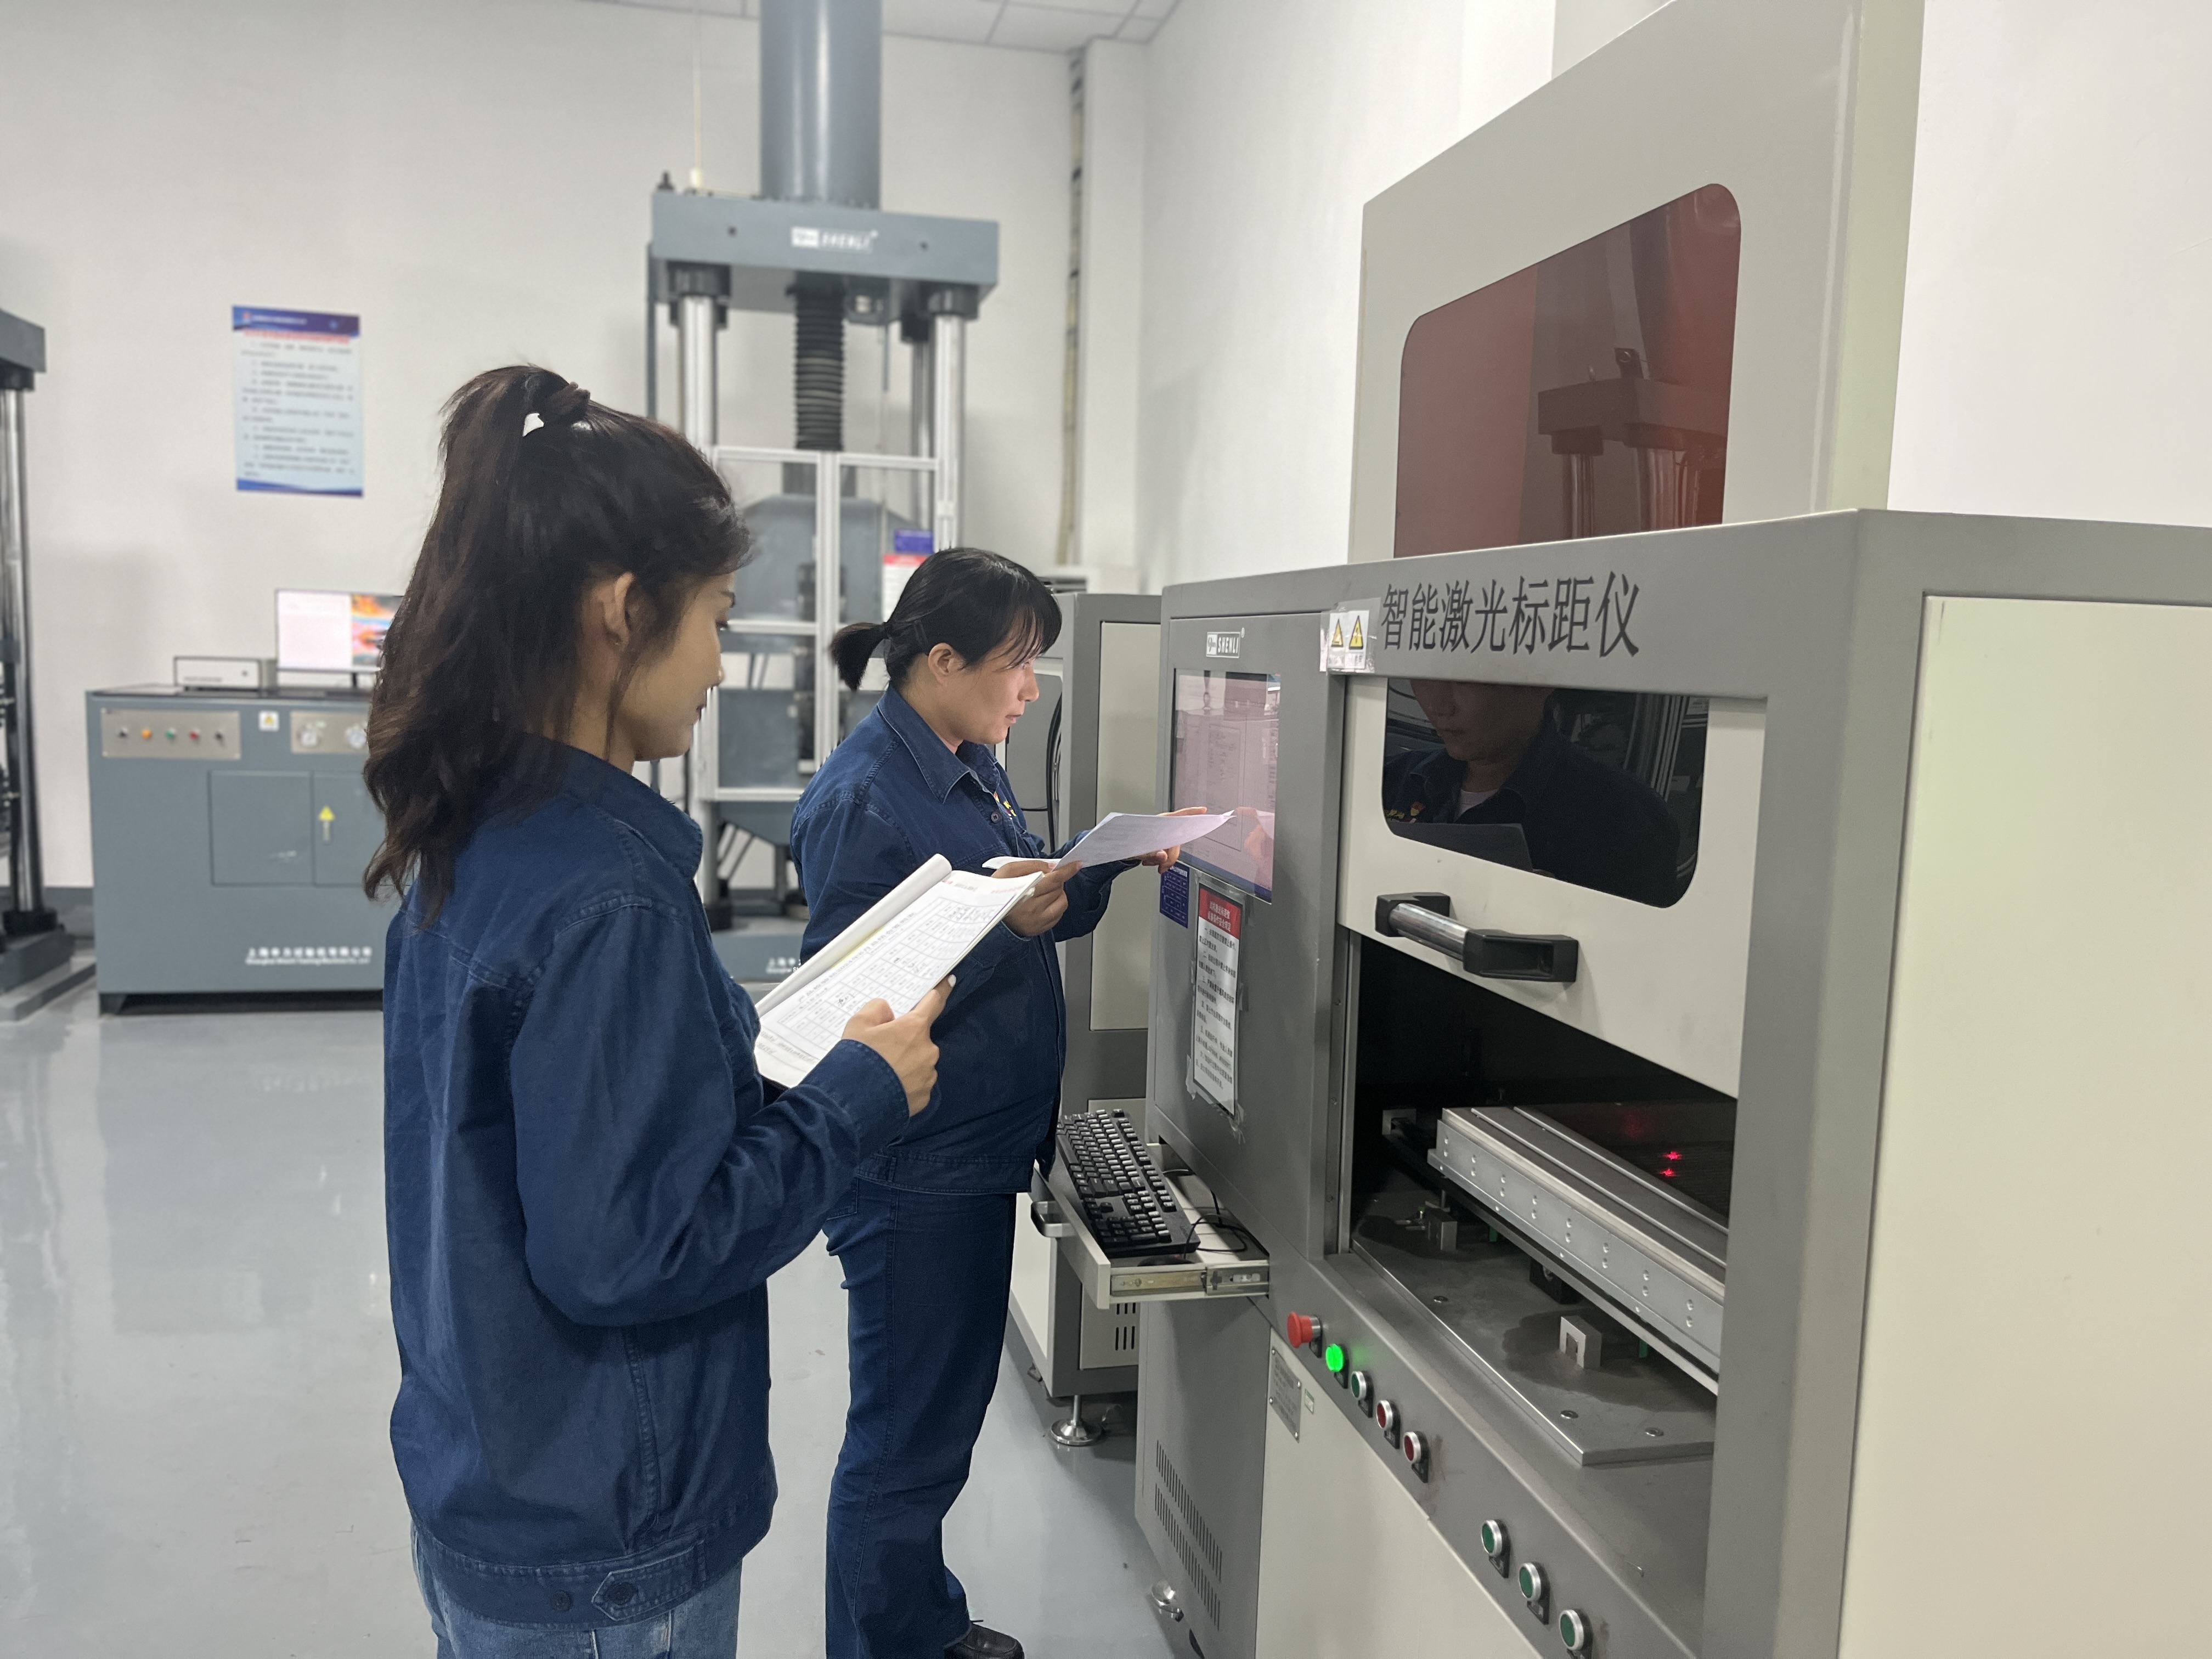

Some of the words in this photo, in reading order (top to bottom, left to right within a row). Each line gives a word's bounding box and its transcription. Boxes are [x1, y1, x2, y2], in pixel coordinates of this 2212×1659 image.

[1380, 571, 1640, 658] 智能激光标距仪
[1217, 636, 1239, 654] SHENLI
